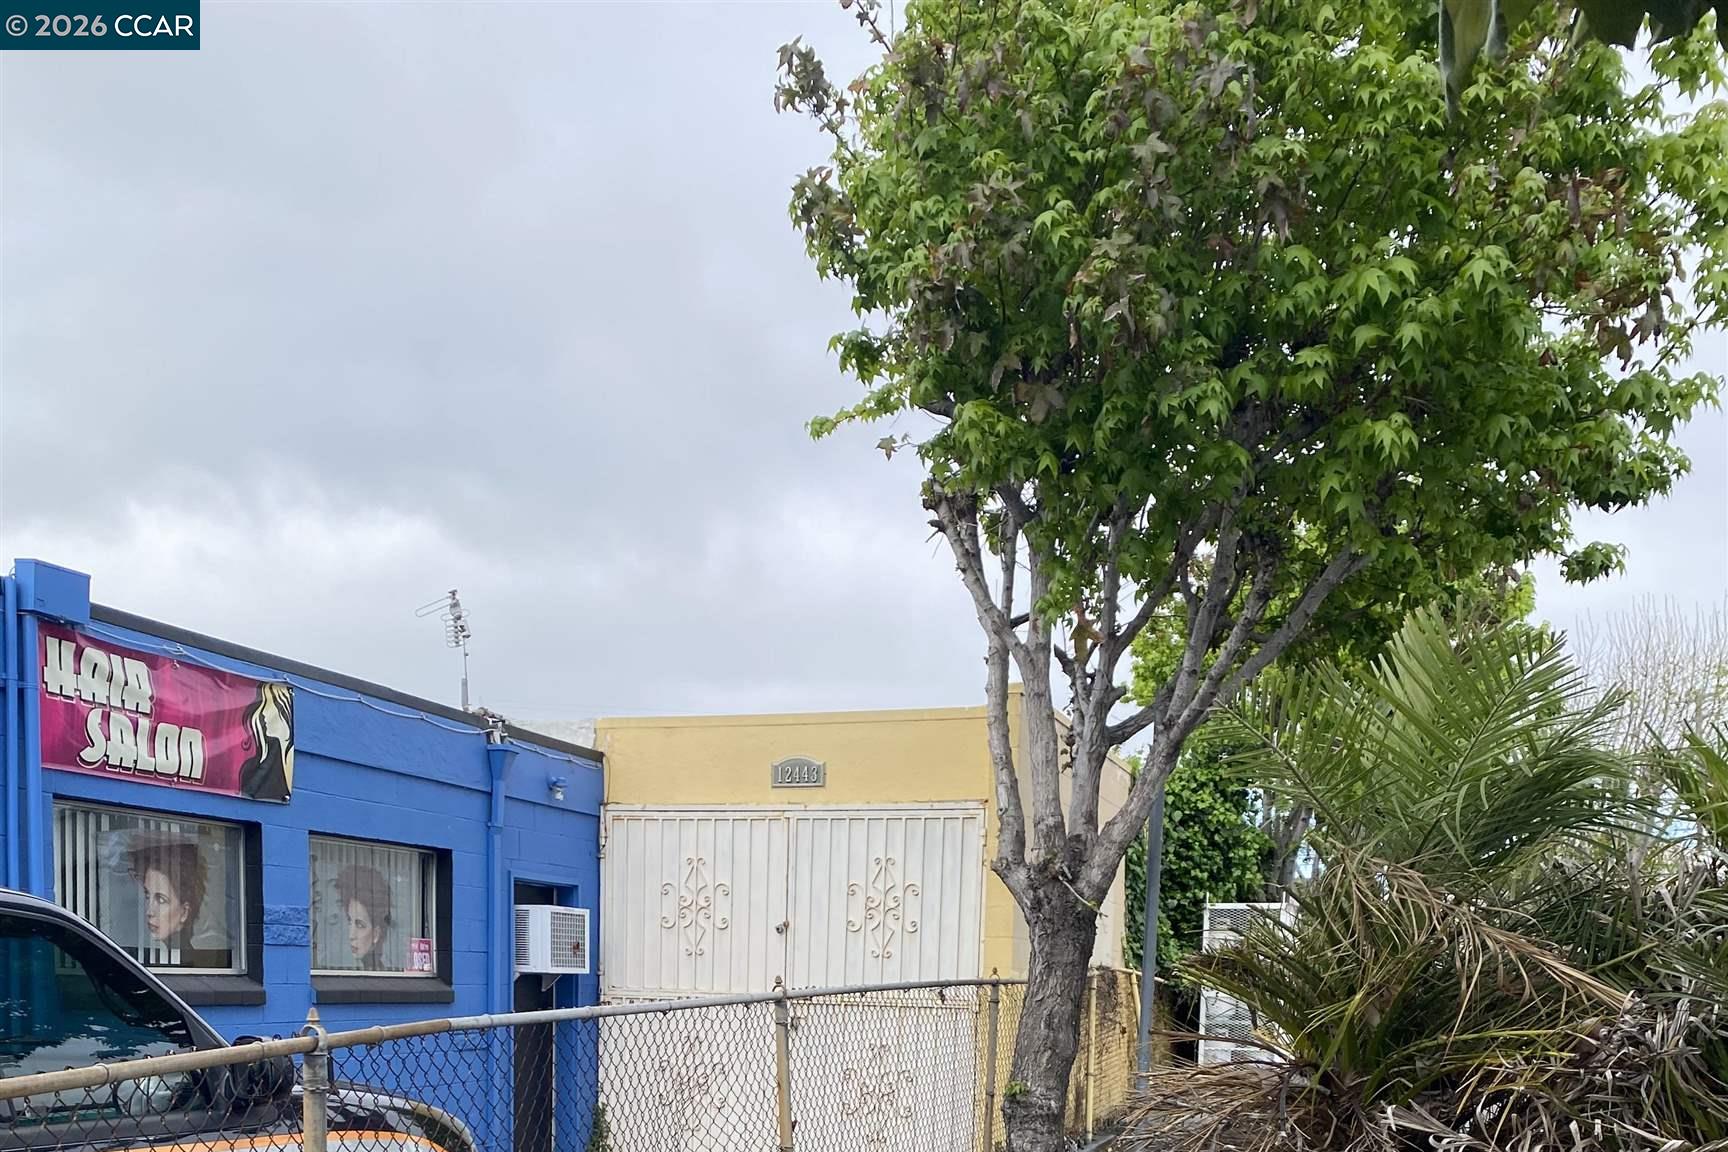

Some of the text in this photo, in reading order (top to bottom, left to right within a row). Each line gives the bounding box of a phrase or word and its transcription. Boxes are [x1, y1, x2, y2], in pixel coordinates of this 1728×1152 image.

[43, 635, 154, 718] HAIR
[77, 708, 206, 785] SALON
[777, 765, 818, 783] 12443
